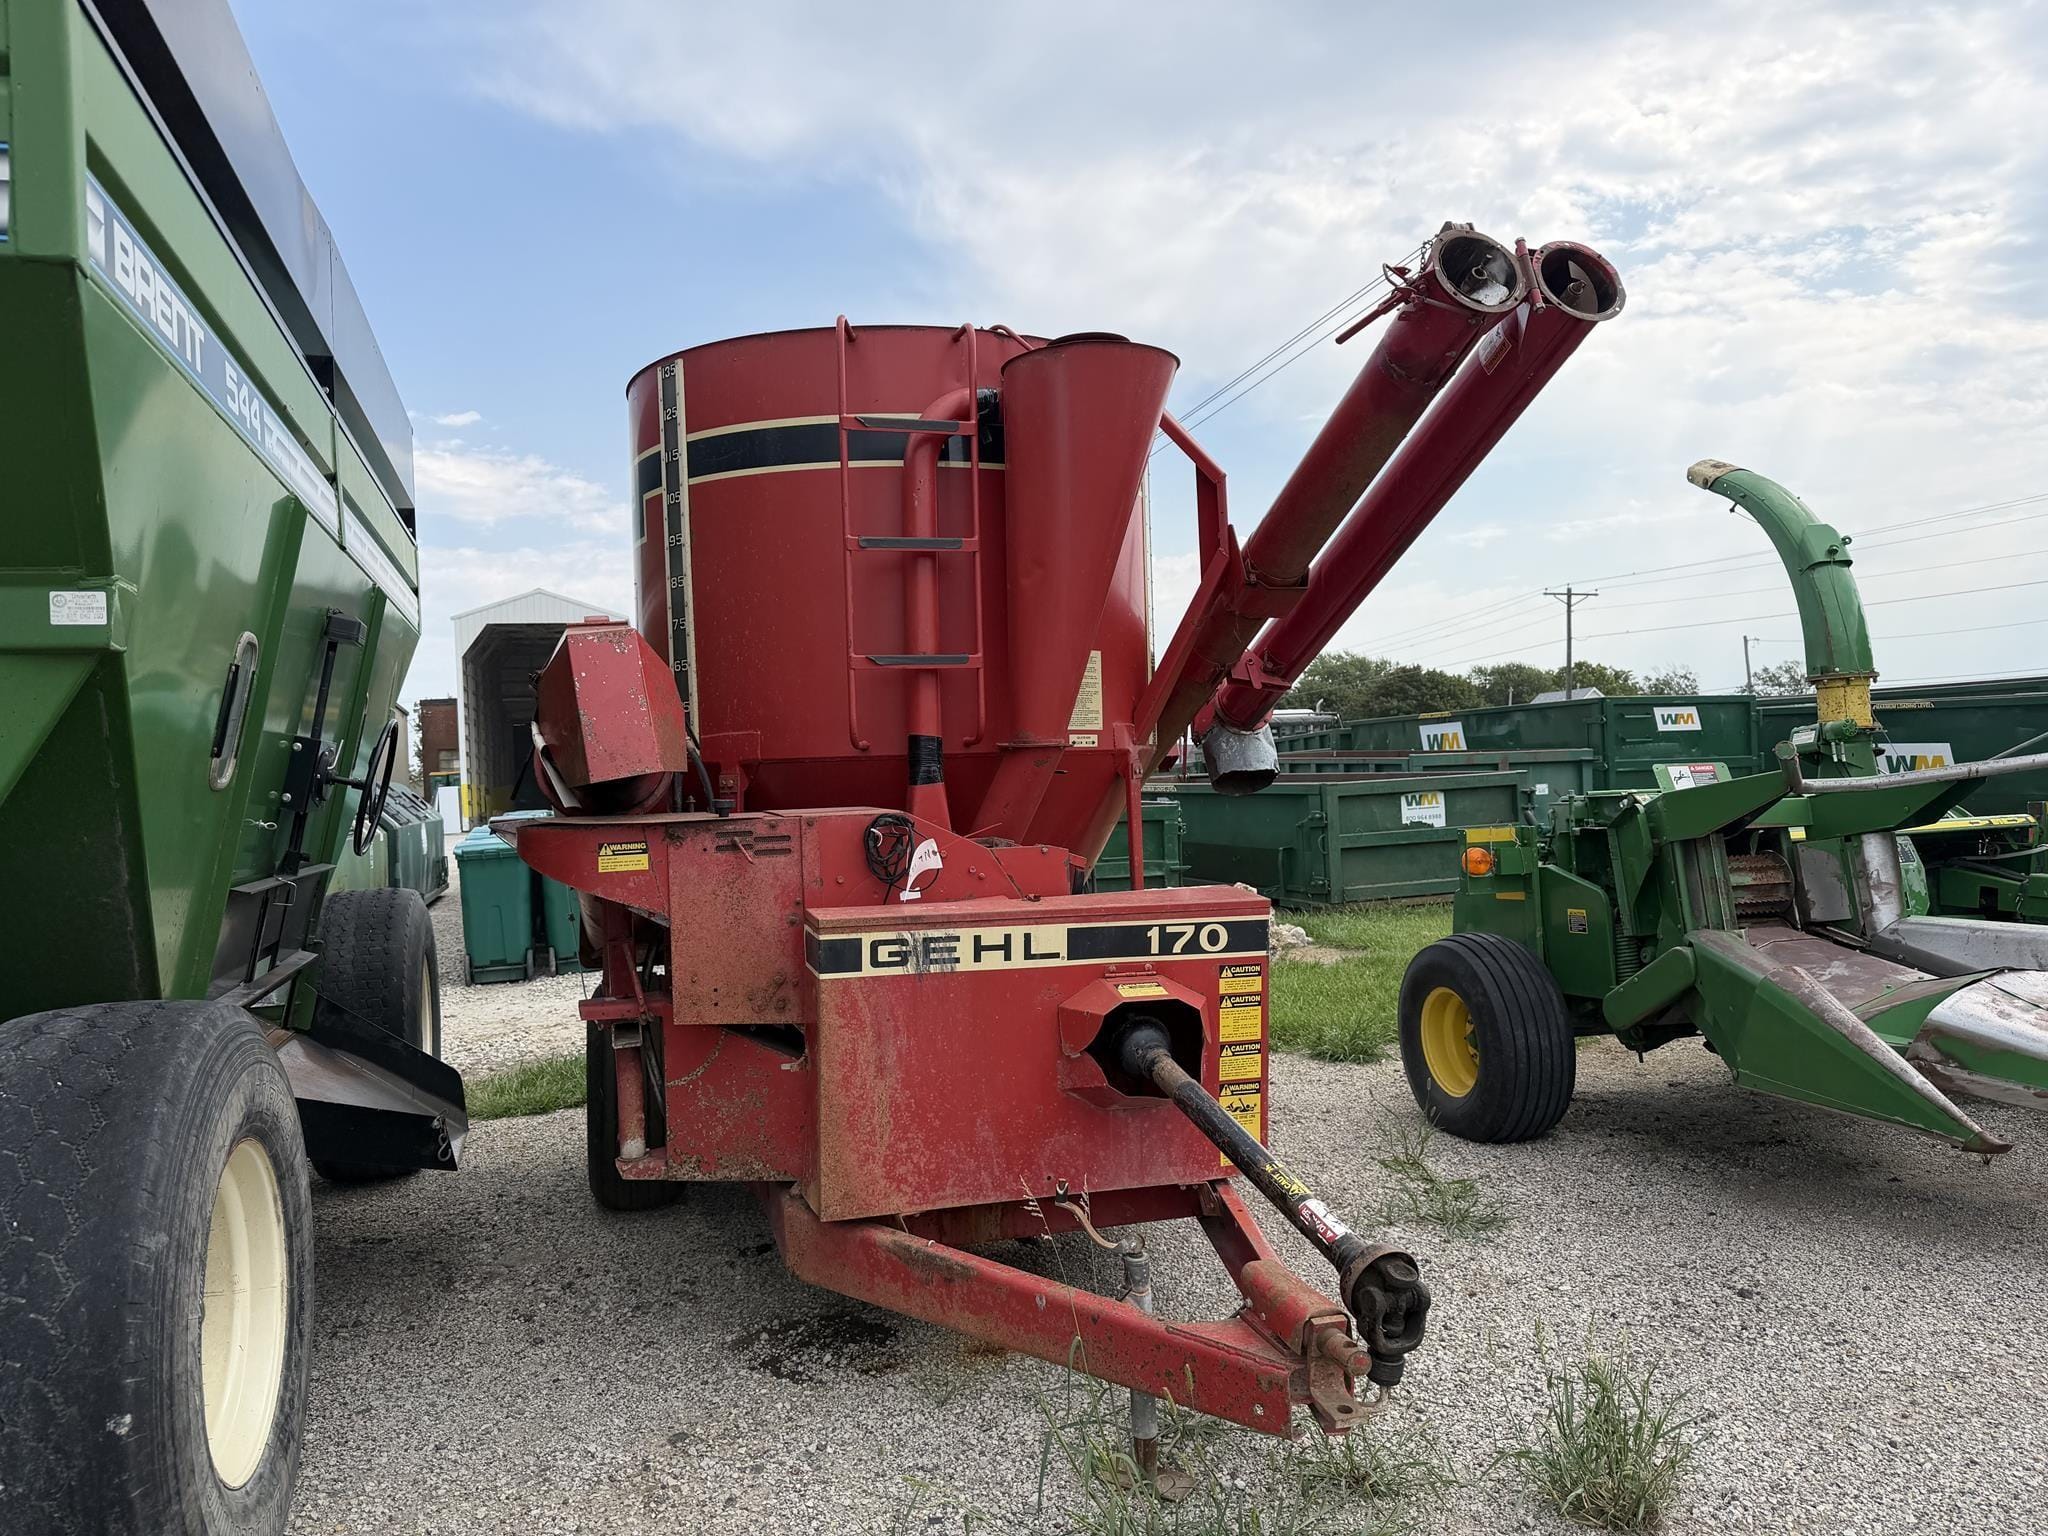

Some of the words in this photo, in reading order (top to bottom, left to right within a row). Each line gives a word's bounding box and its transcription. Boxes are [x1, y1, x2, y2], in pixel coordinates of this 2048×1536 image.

[113, 218, 204, 373] BRENT
[225, 360, 261, 441] 544
[662, 363, 676, 379] 135
[664, 406, 677, 421] 125
[665, 448, 679, 463] 115
[667, 492, 681, 505] 105
[669, 534, 682, 547] 95
[670, 576, 684, 589] 85
[672, 618, 686, 631] 75
[674, 660, 688, 672] 65
[1661, 713, 1695, 725] WM
[1426, 732, 1460, 750] WM
[1885, 755, 1945, 774] WM
[1405, 791, 1440, 807] WM
[609, 842, 646, 851] WARNING
[1147, 923, 1229, 955] 170
[869, 931, 1061, 969] GEHL
[1231, 965, 1261, 973] CAUTION
[1231, 995, 1261, 1003] CAUTION
[1231, 1043, 1261, 1052] CAUTION
[1229, 1083, 1260, 1091] WARNING
